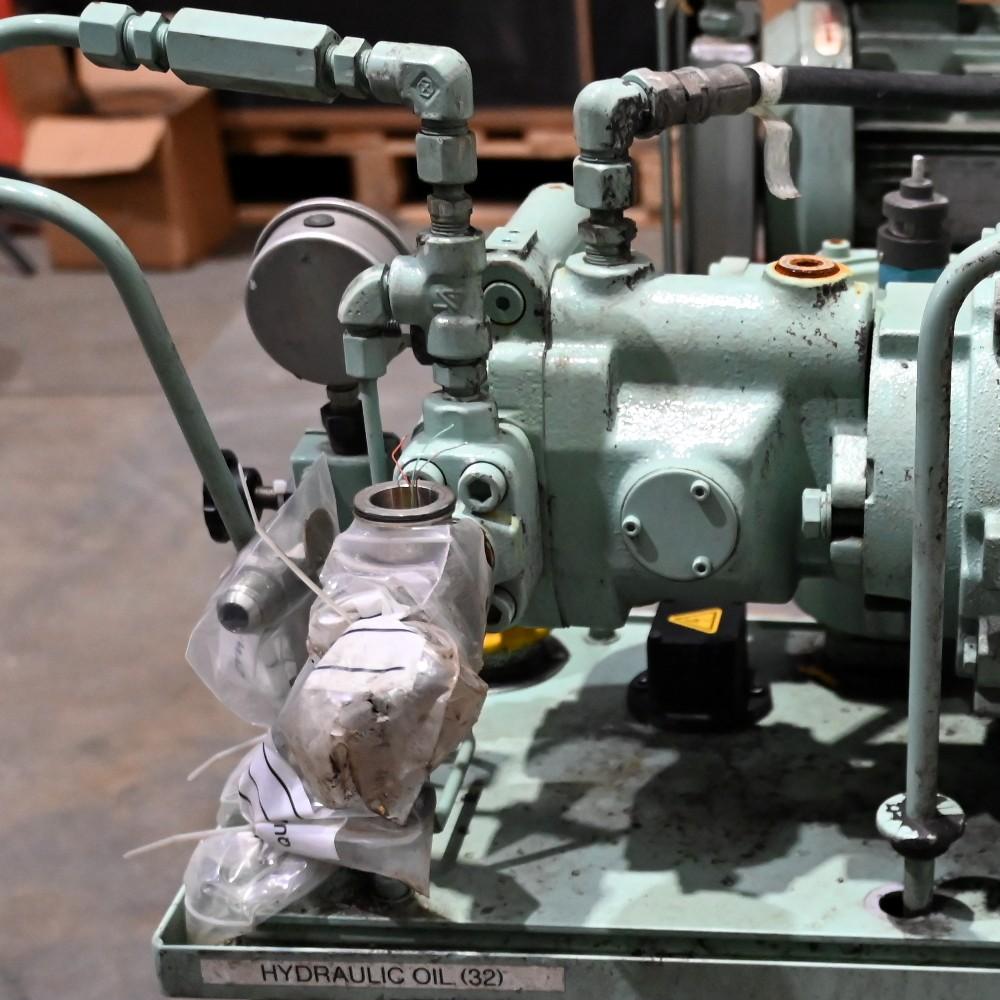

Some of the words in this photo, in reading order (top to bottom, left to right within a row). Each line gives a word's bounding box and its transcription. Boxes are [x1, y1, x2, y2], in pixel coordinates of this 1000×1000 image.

[260, 963, 405, 985] HYDRAULIC
[412, 966, 457, 987] OIL
[460, 968, 504, 988] (32)
